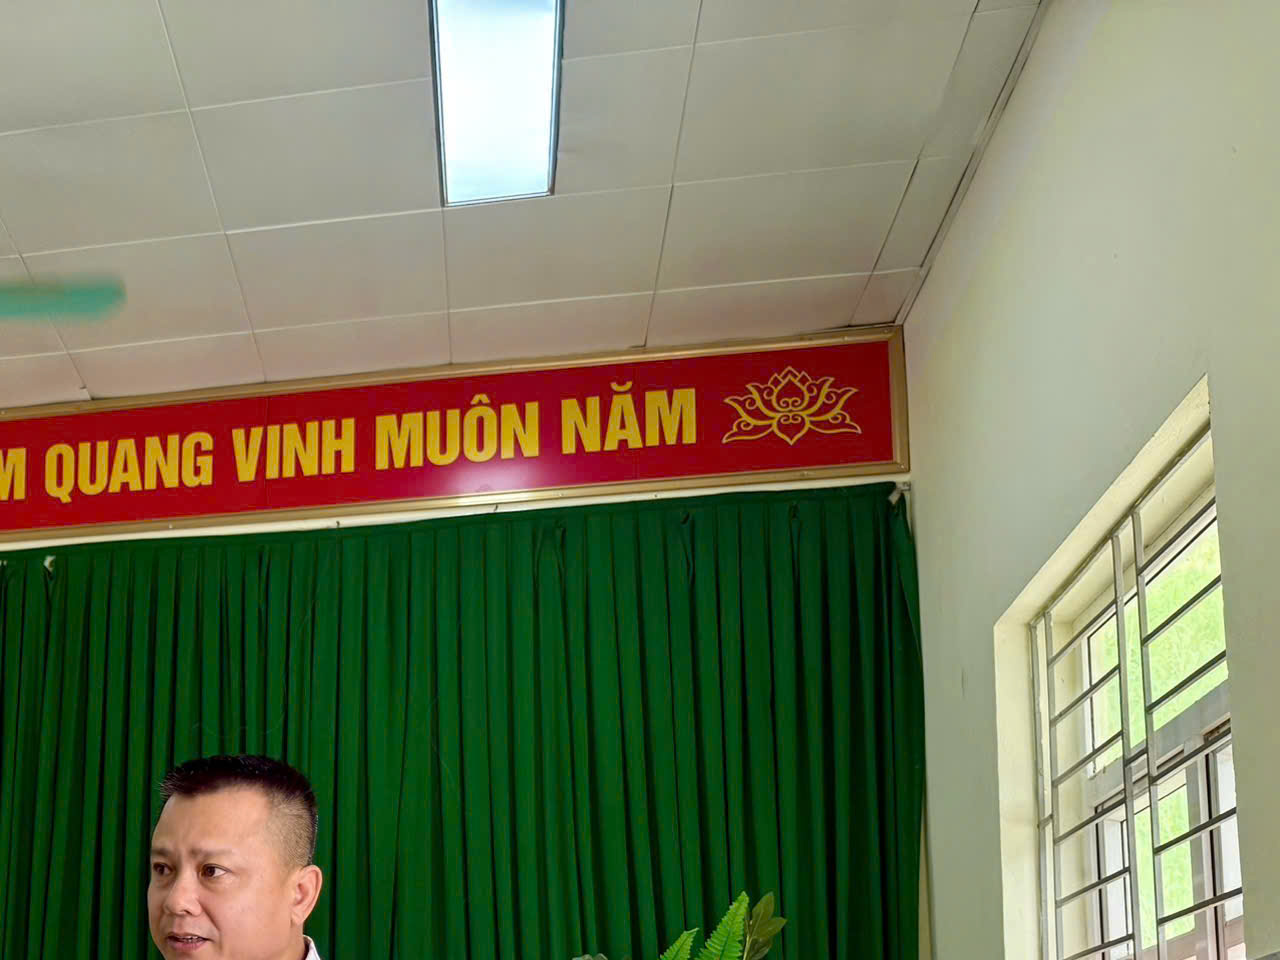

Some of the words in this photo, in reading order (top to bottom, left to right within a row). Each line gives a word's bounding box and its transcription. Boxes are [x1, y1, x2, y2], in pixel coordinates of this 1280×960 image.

[44, 432, 214, 505] QUANG
[231, 418, 356, 483] VINH
[374, 393, 541, 471] MUÔN
[560, 378, 698, 455] NĂM
